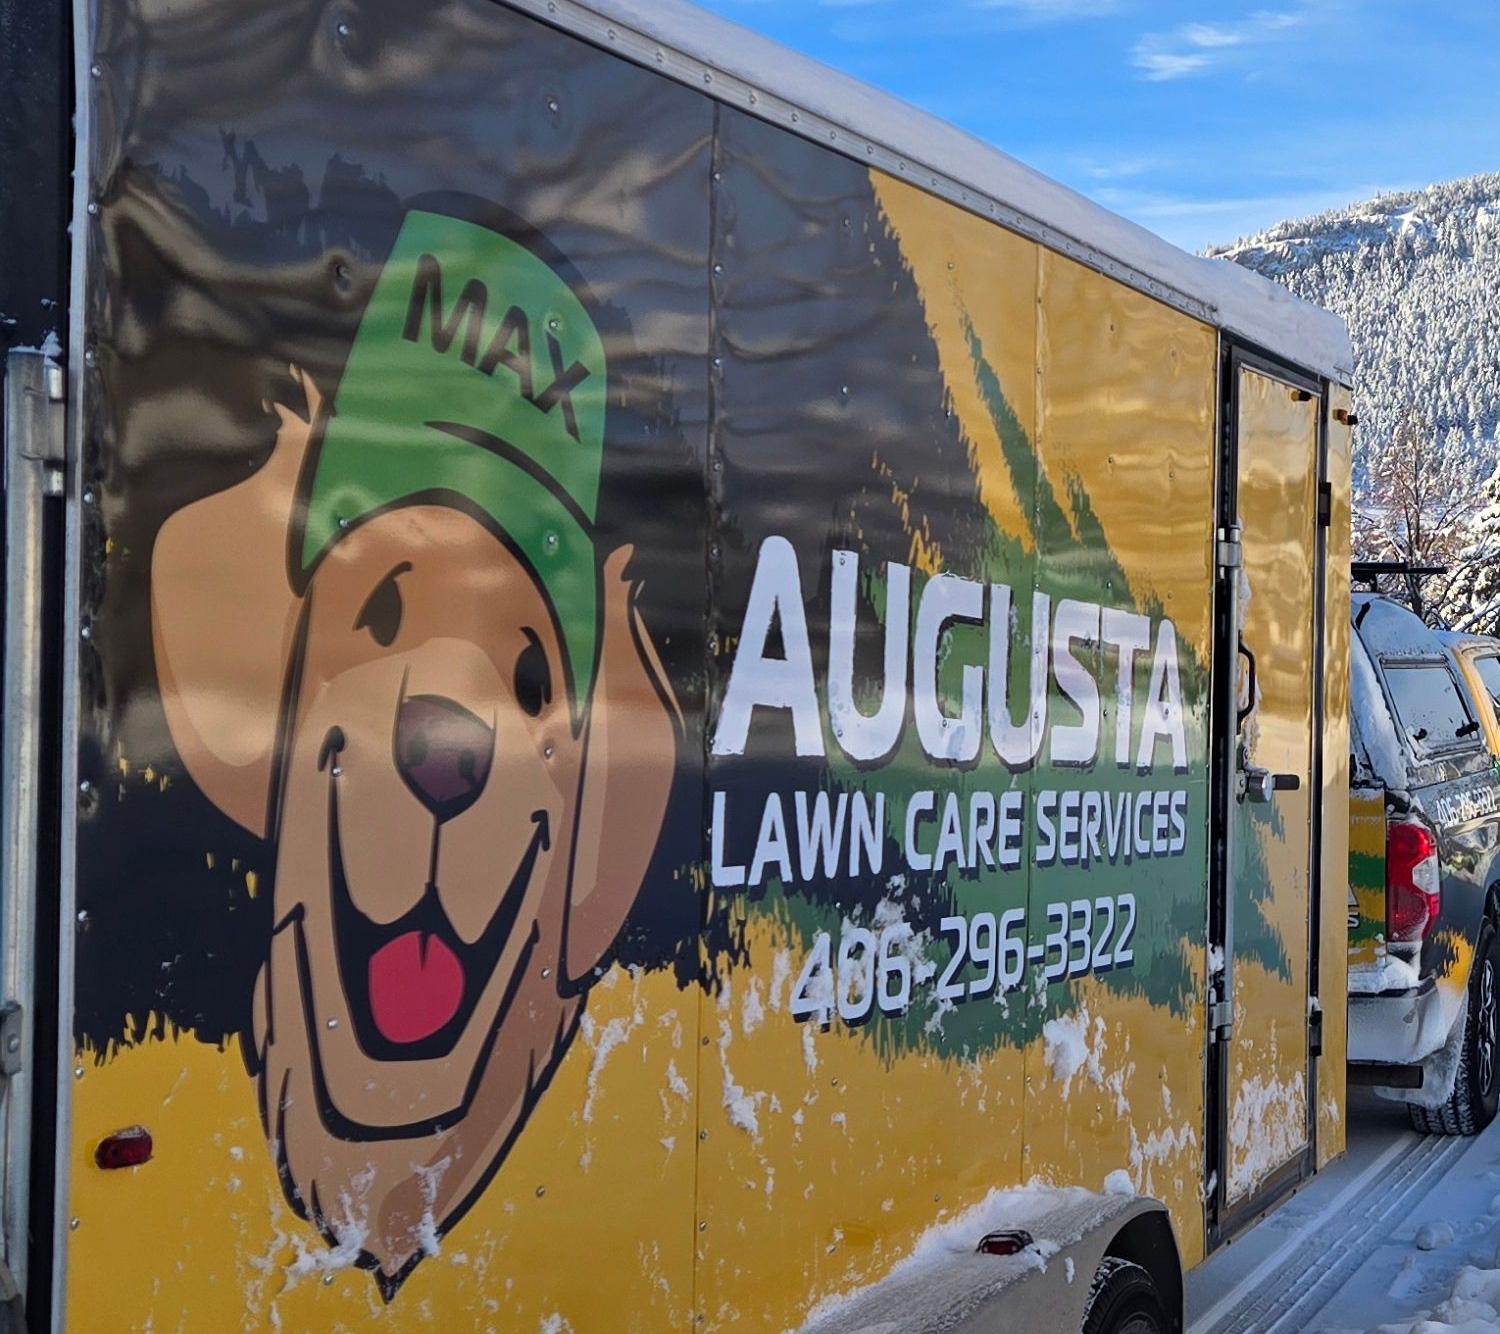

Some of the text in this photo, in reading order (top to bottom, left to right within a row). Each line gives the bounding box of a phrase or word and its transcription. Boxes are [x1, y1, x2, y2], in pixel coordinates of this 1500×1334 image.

[402, 253, 591, 444] MAX
[711, 535, 1187, 767] AUGUSTA
[712, 790, 1187, 887] LAWN CARE SERVICES
[790, 888, 1136, 1024] 406-296-3322
